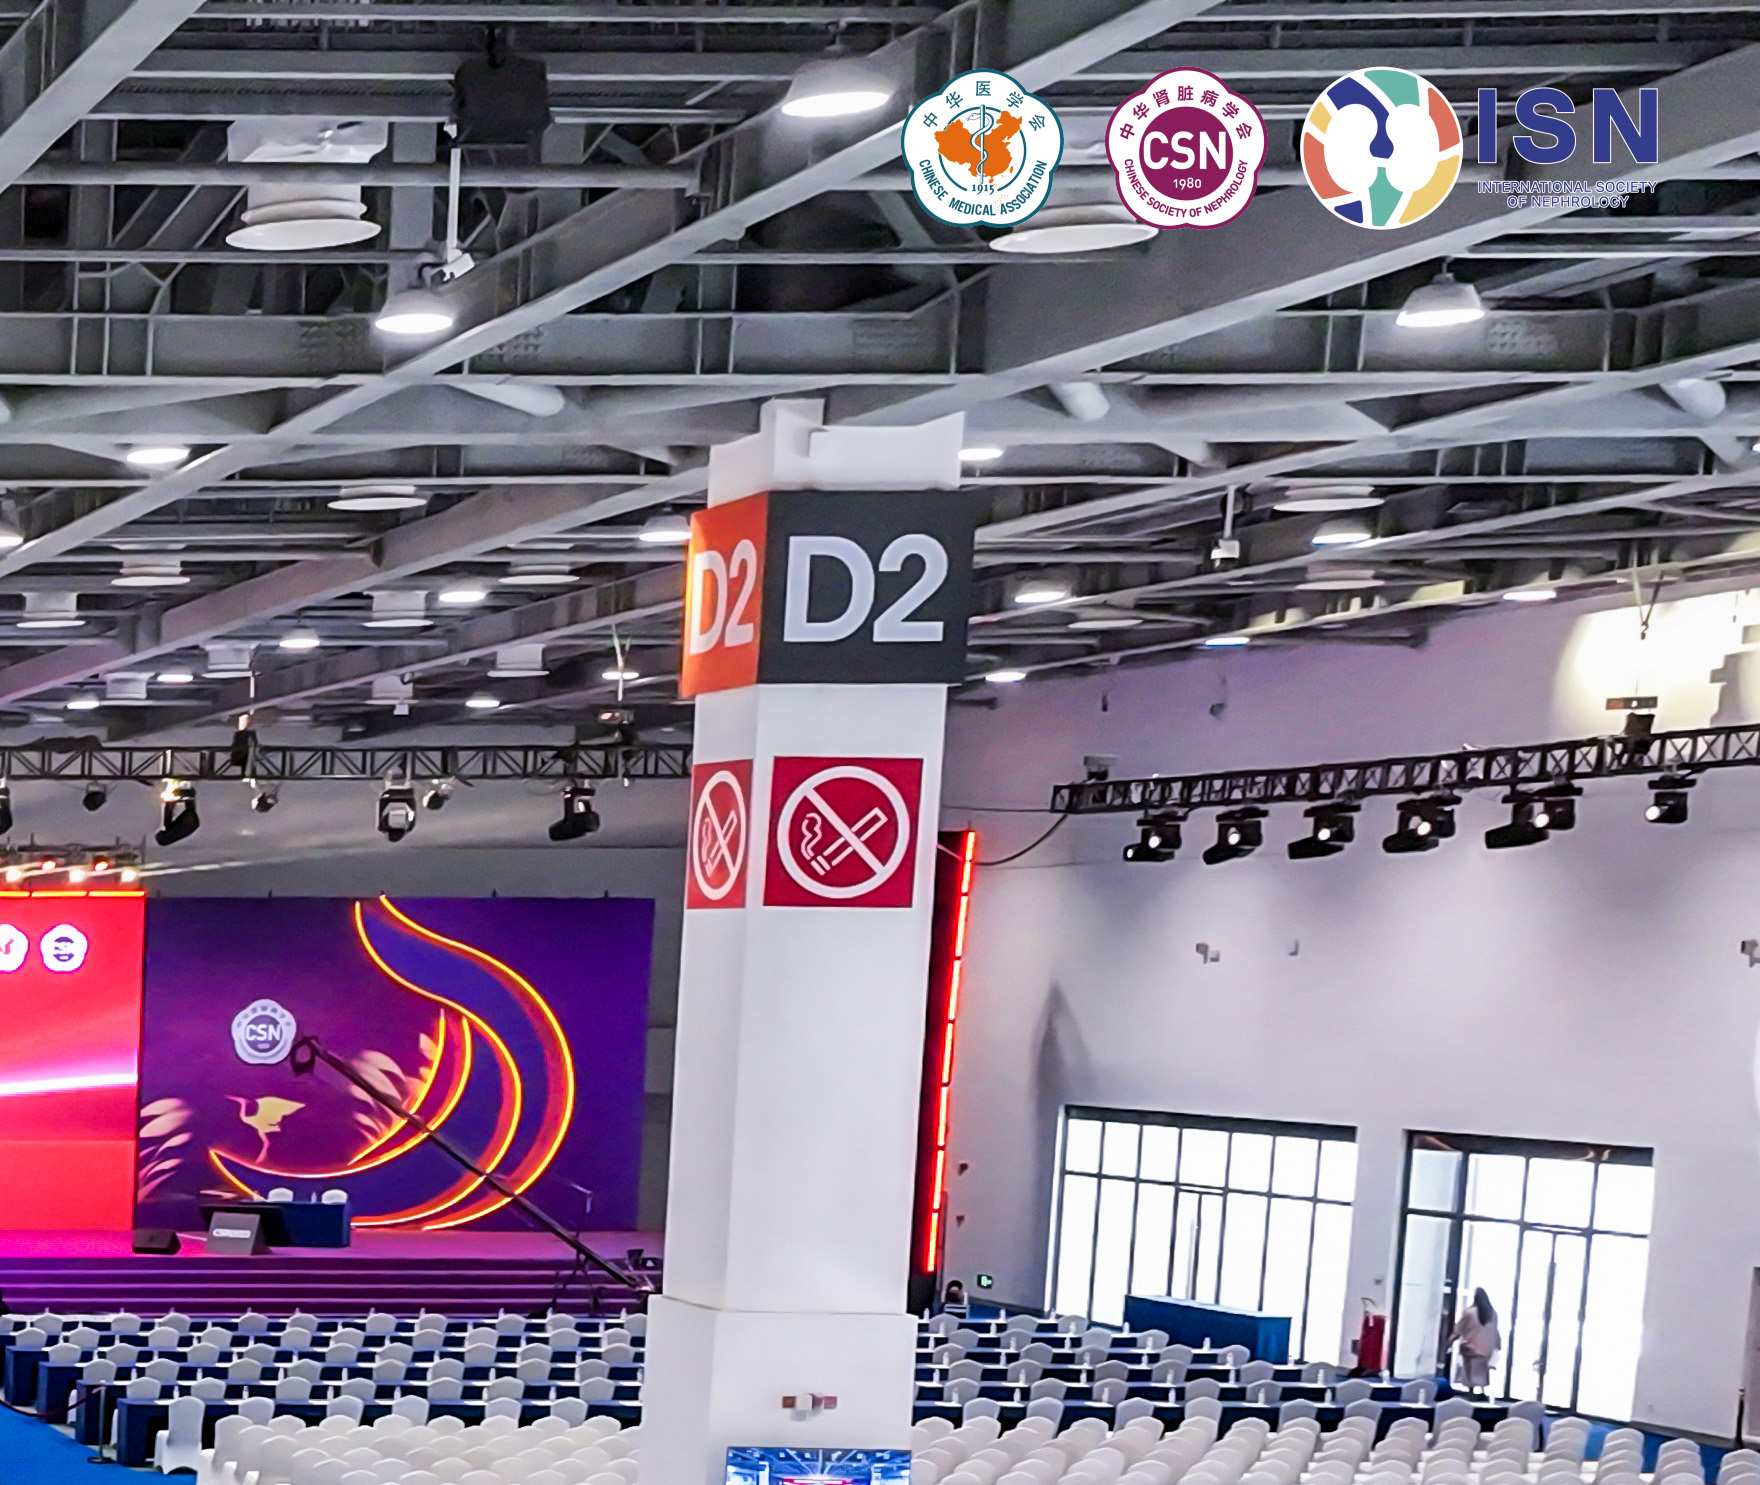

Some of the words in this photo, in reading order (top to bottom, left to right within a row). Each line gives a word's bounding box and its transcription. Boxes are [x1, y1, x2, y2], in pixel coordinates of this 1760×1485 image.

[689, 539, 757, 657] D2
[783, 533, 949, 643] D2
[246, 1024, 280, 1041] CSN
